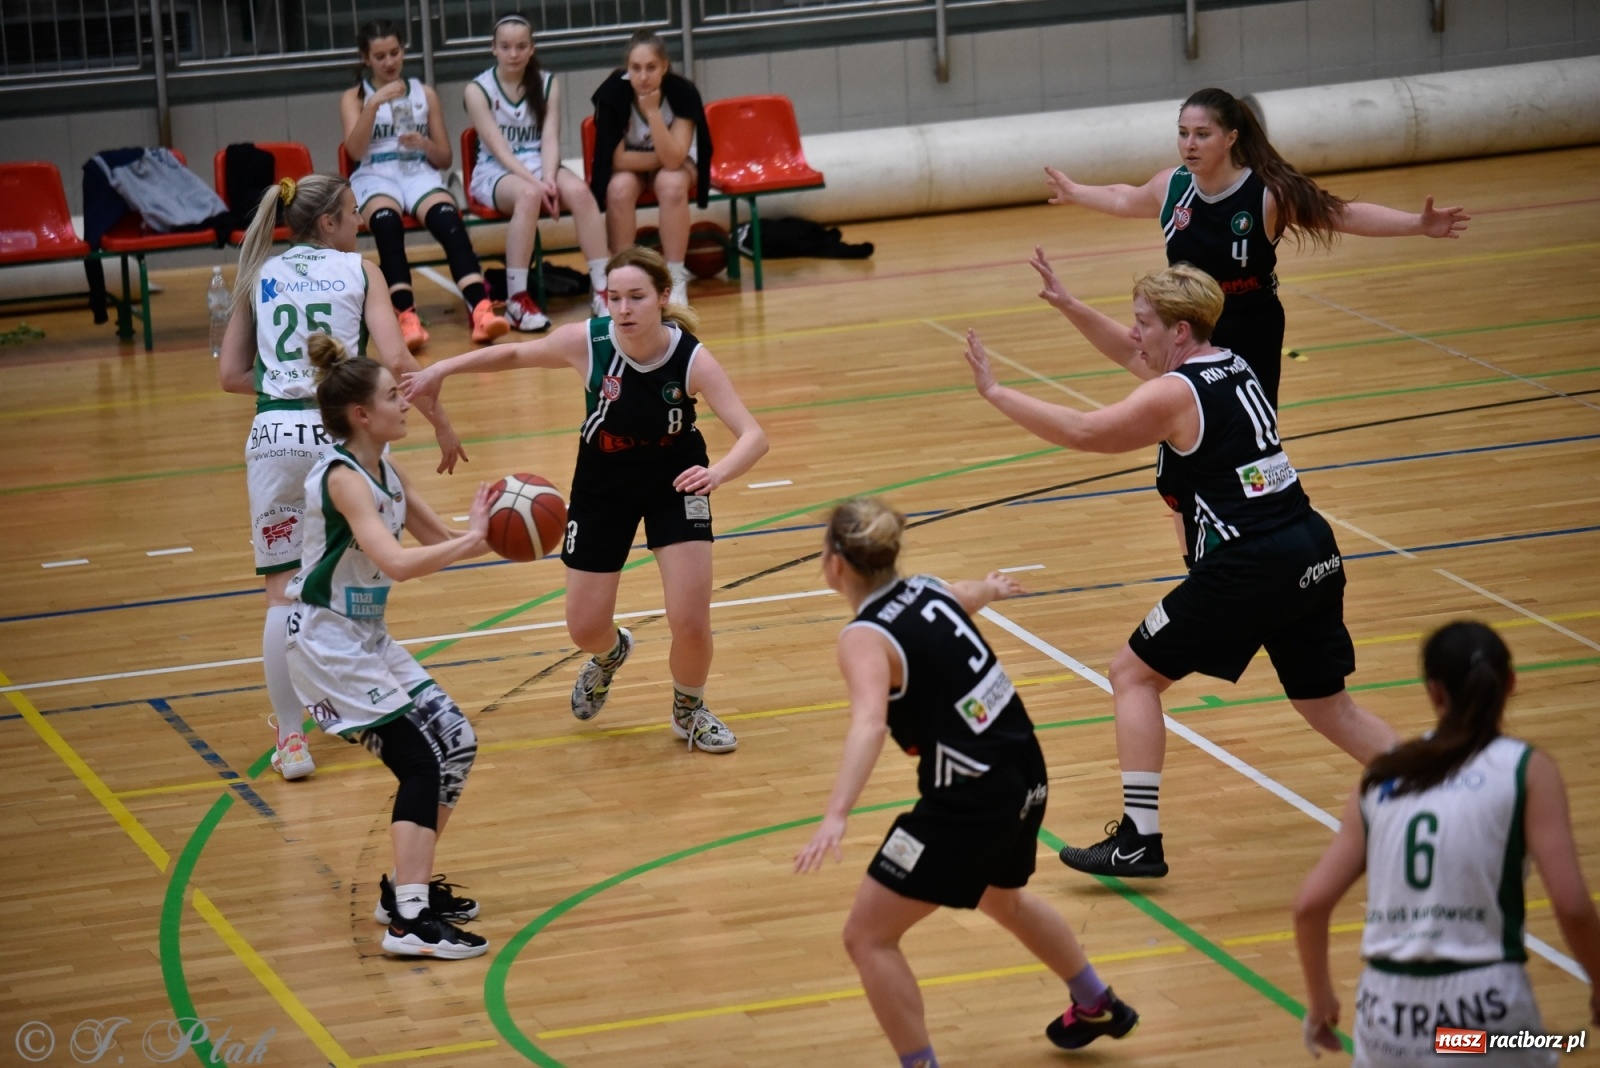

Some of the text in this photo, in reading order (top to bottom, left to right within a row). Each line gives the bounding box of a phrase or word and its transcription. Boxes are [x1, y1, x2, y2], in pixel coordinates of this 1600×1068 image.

[1232, 239, 1248, 267] 4
[261, 278, 346, 303] KOMPLIDO
[273, 303, 332, 362] 25
[668, 408, 682, 434] 8
[1236, 379, 1280, 450] 10
[251, 423, 336, 449] BAT-TR
[566, 520, 578, 554] 8
[920, 599, 989, 674] 3
[1404, 810, 1439, 890] 6
